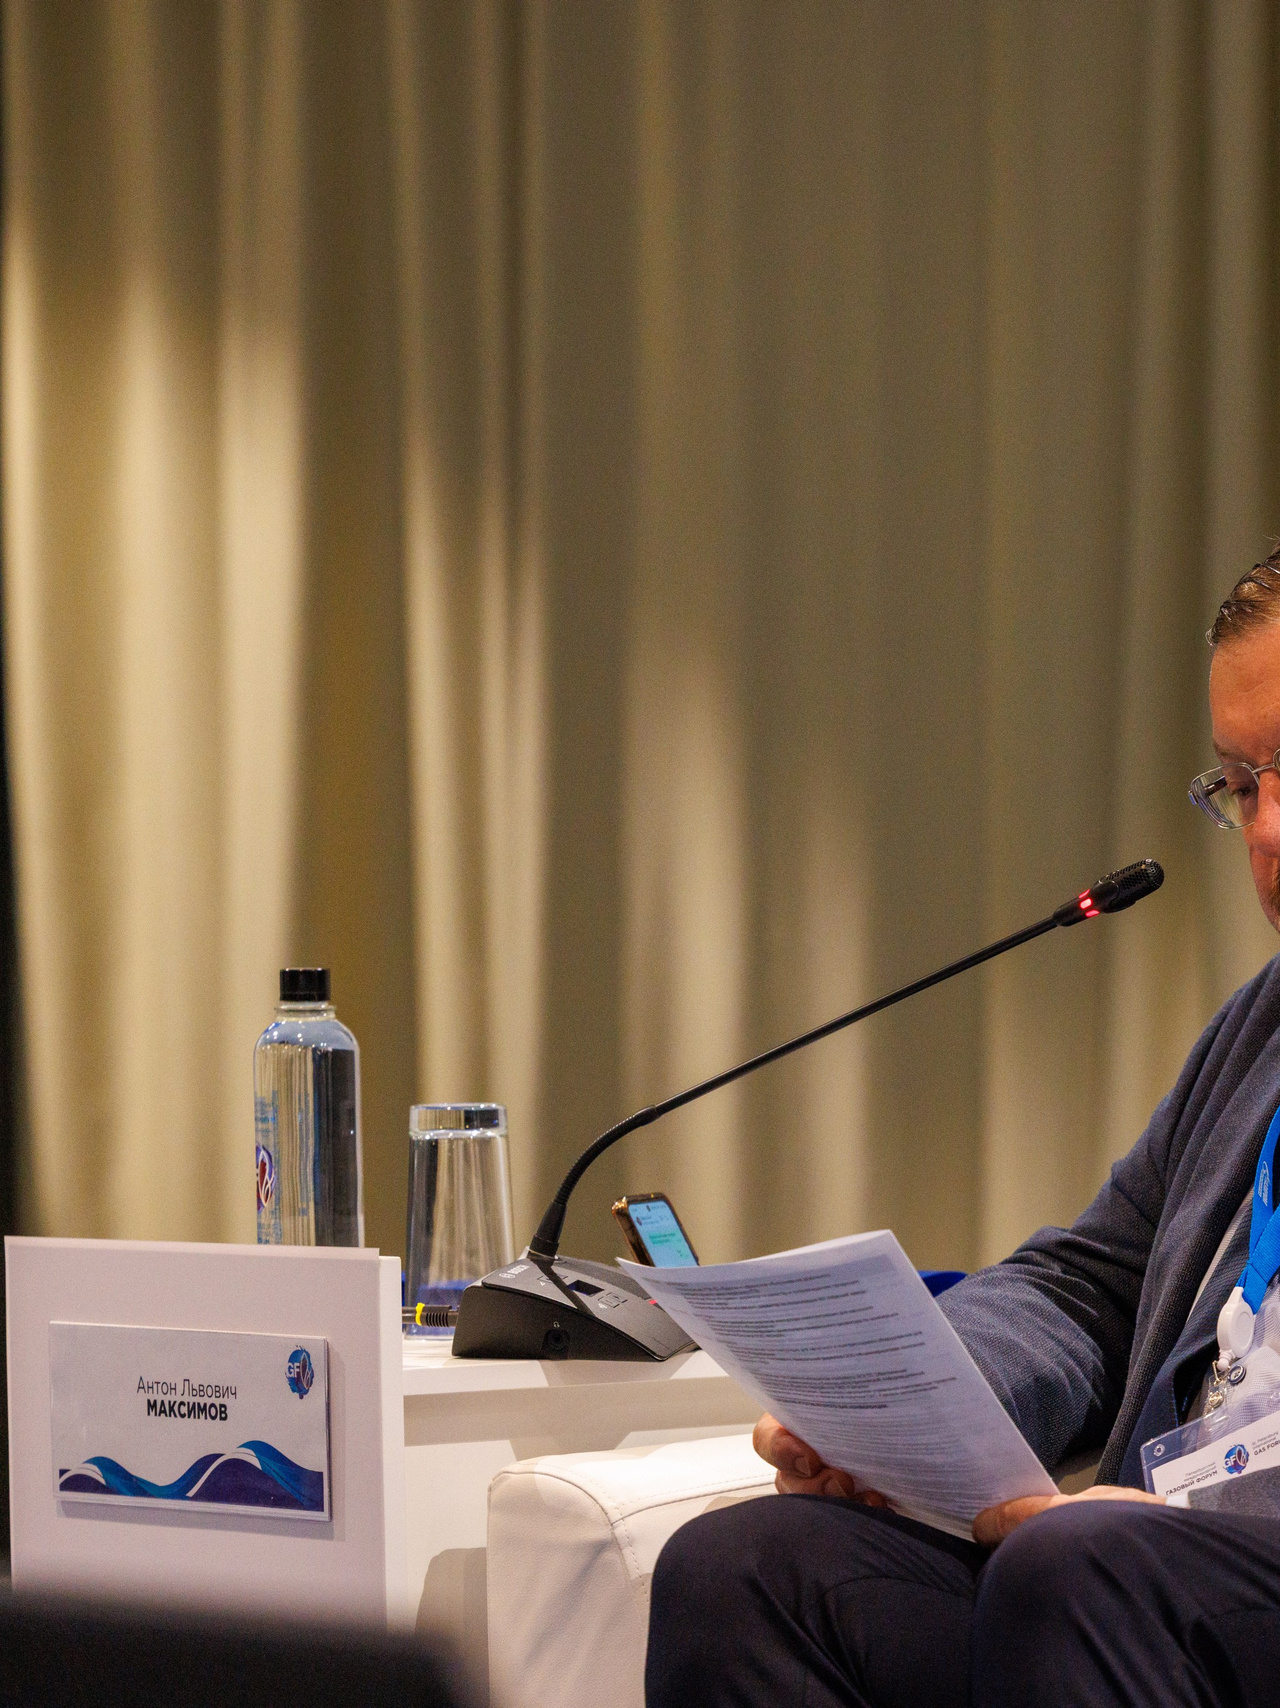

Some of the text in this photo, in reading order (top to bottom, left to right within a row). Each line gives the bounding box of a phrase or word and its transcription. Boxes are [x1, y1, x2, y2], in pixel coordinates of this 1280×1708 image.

[287, 1362, 300, 1378] GF
[136, 1376, 237, 1400] Антон Львович
[146, 1398, 228, 1422] МАКСИМОВ
[1253, 1446, 1266, 1456] GAS
[1222, 1455, 1236, 1468] GF
[1165, 1470, 1218, 1496] ГАЗОВЫЙ ФОРУМ
